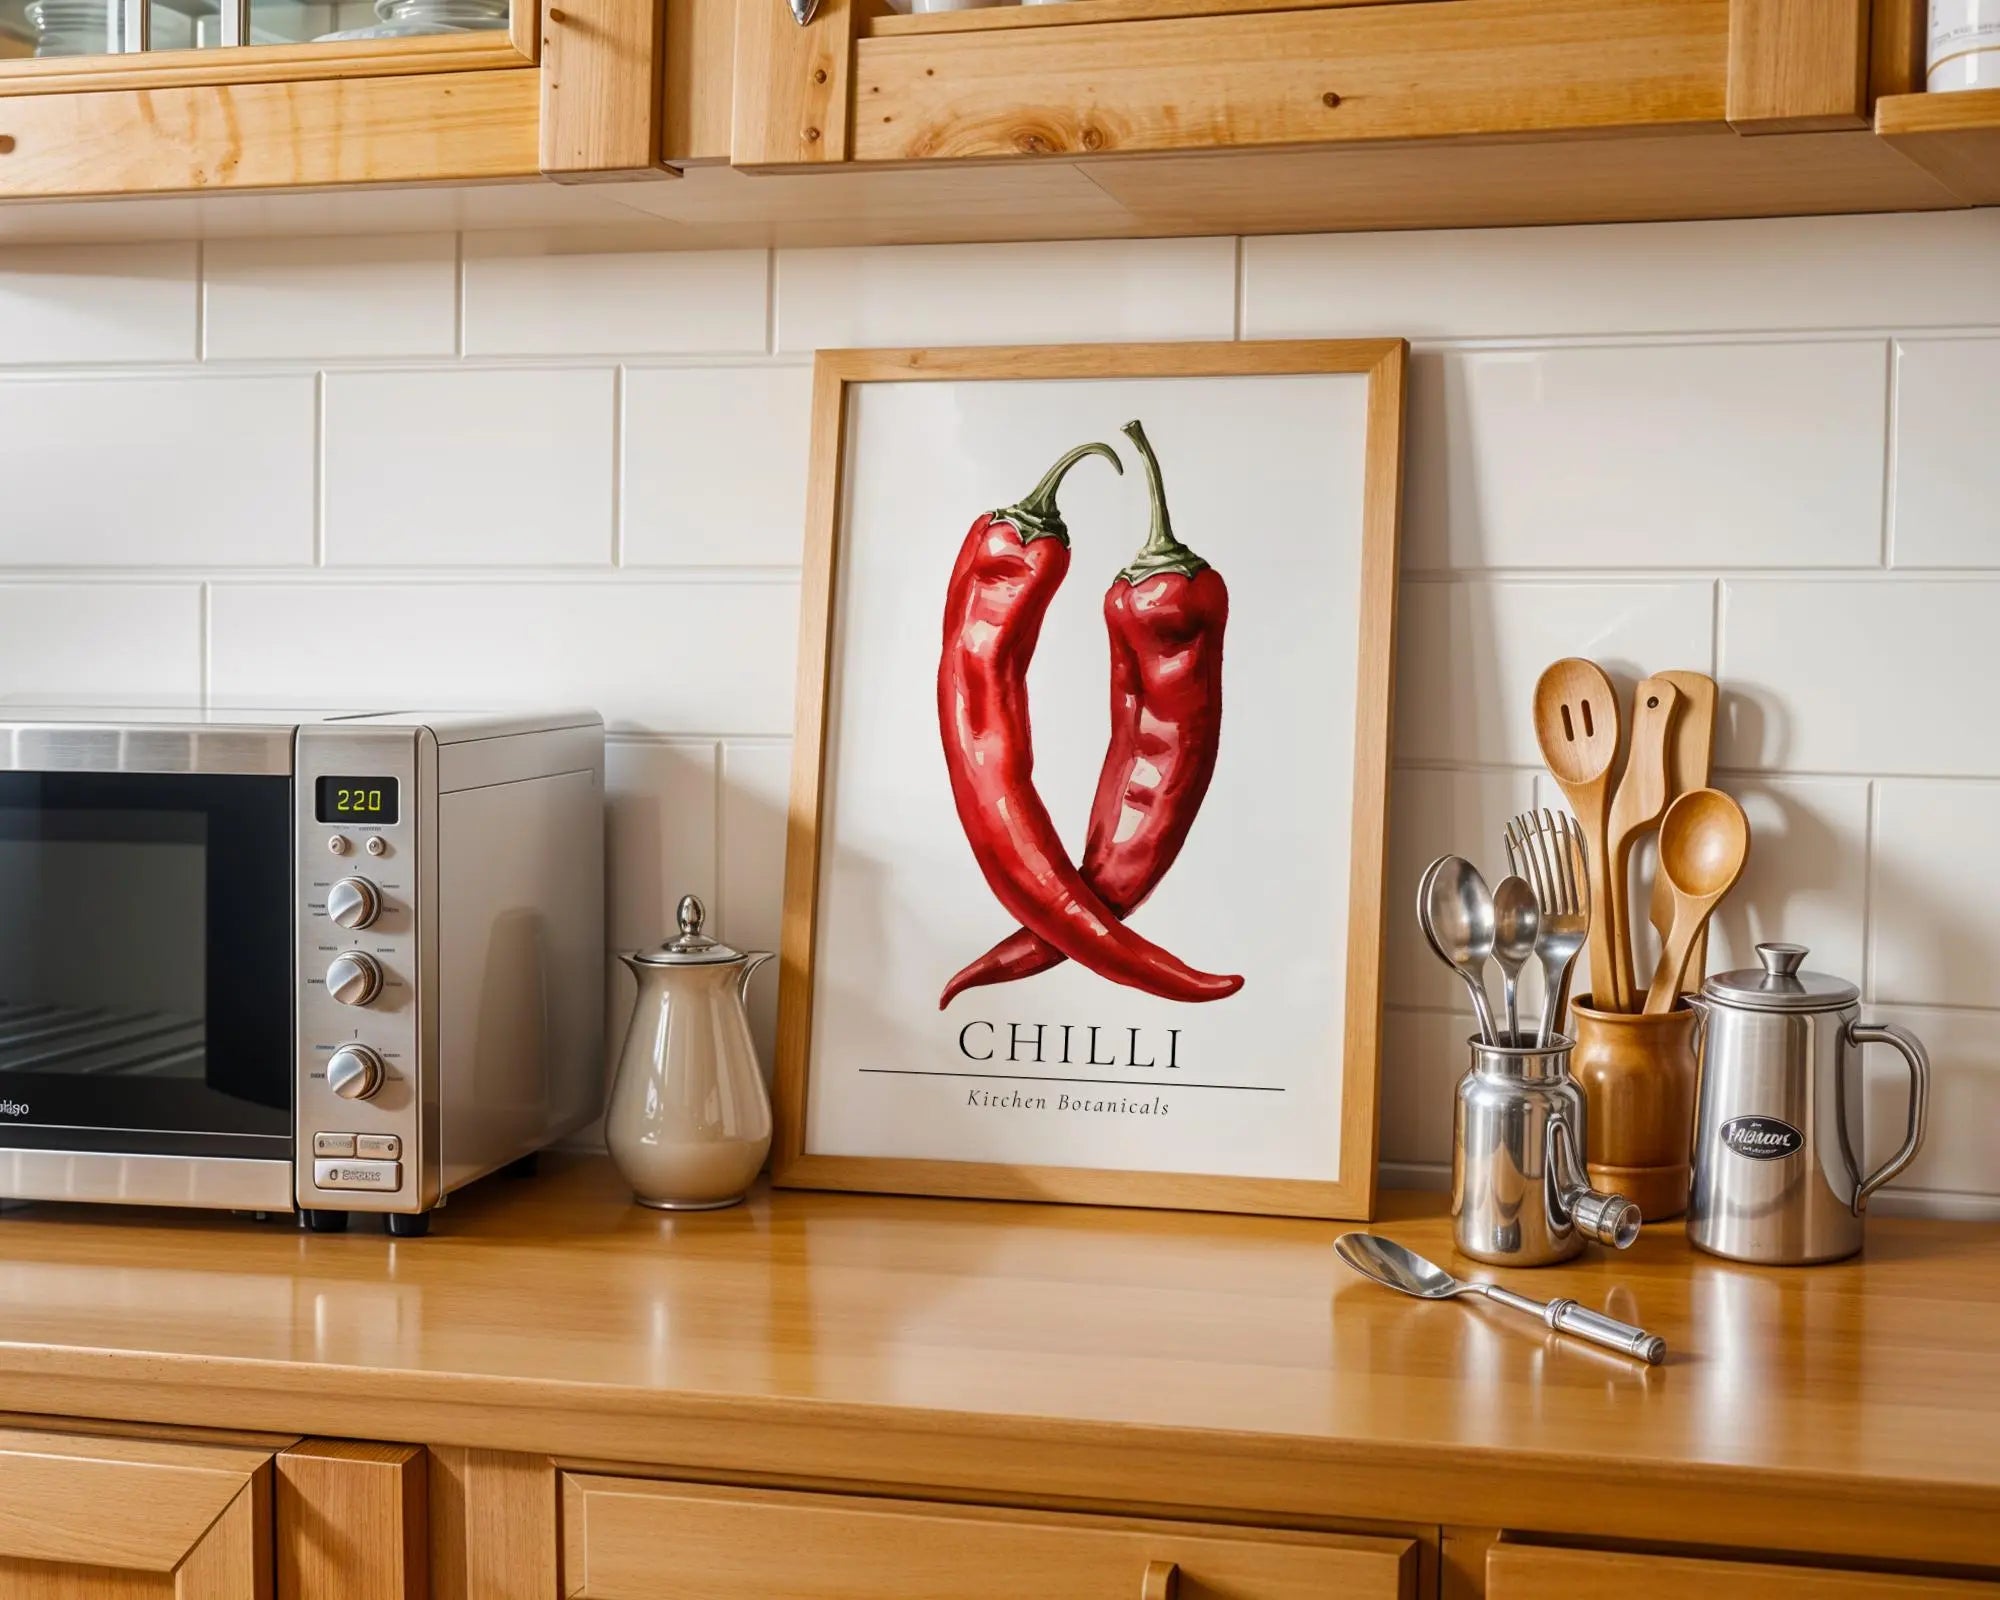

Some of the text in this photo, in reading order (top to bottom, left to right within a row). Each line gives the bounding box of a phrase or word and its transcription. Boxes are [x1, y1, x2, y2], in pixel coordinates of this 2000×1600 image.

[337, 789, 381, 811] 220
[958, 1020, 1182, 1069] CHILLI
[967, 1089, 1169, 1116] Kitchen Botanicals
